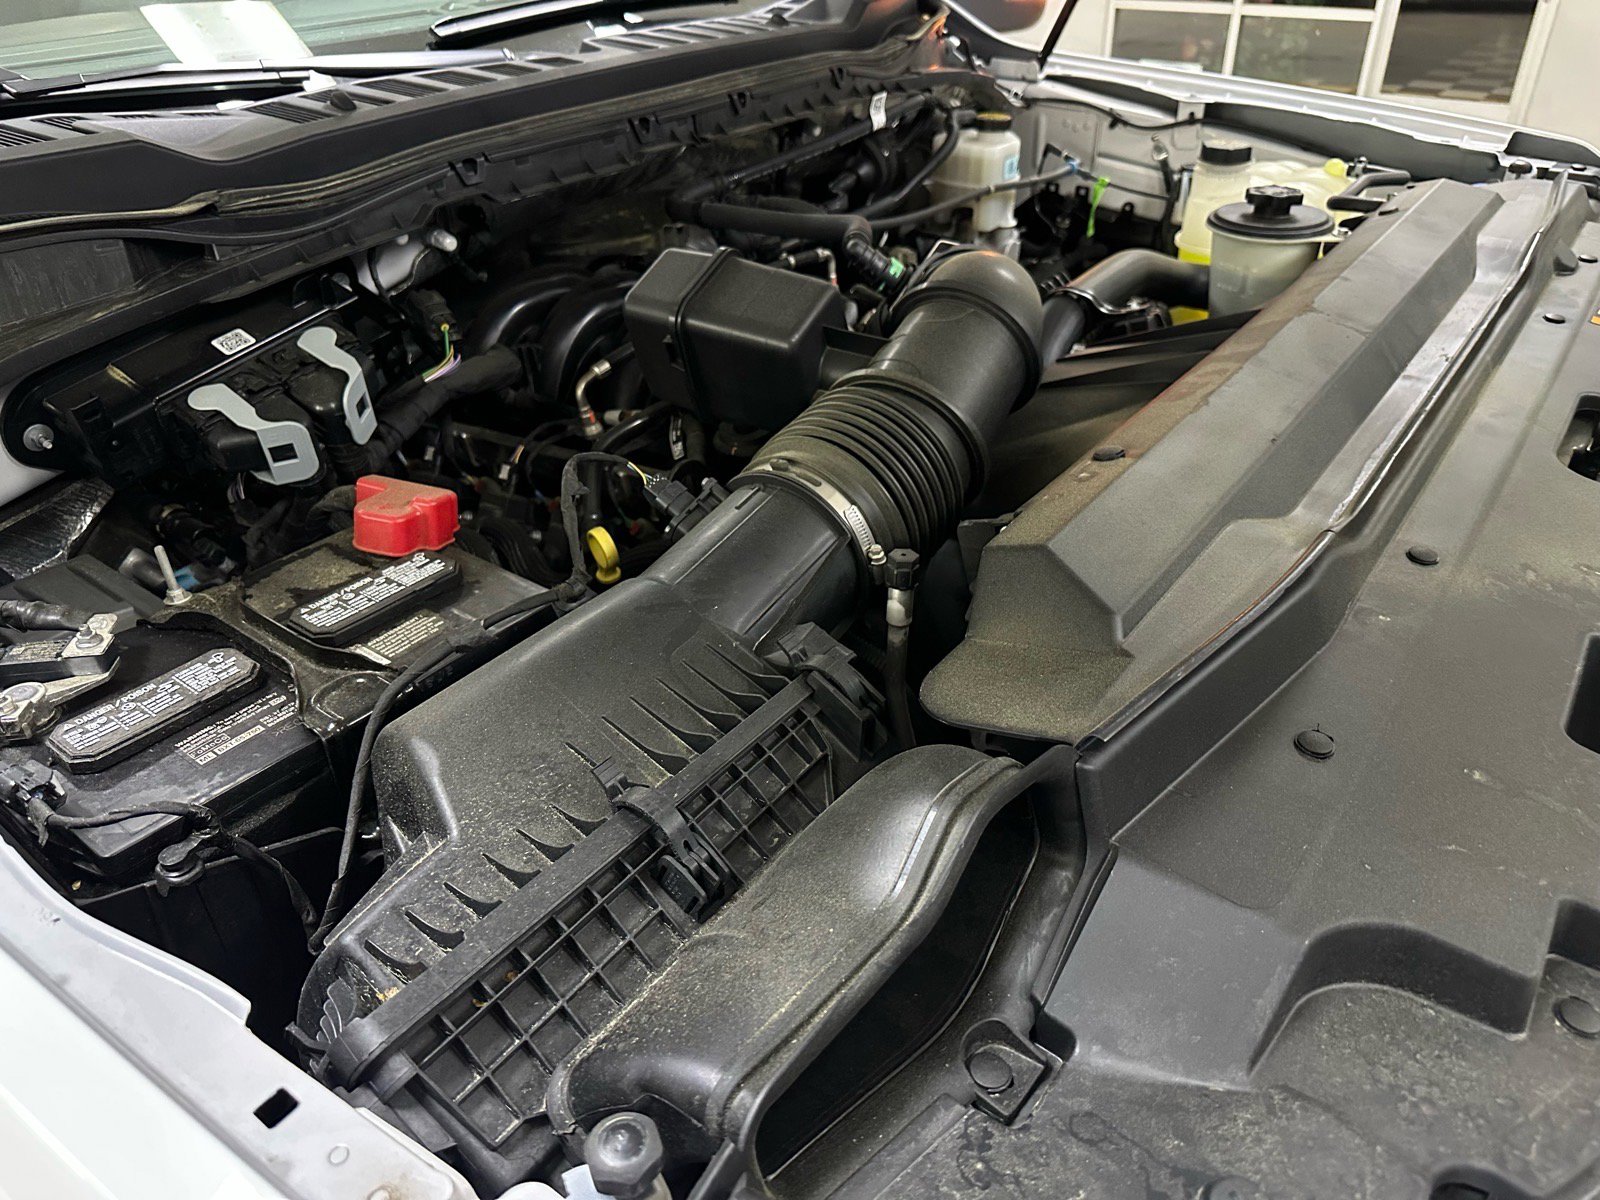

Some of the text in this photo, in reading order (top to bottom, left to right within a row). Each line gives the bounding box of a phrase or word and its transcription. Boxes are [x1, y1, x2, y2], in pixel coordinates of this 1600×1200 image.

[308, 593, 341, 609] DANGER
[345, 577, 374, 593] POISON
[75, 704, 115, 724] DANGER
[121, 683, 157, 704] POISON
